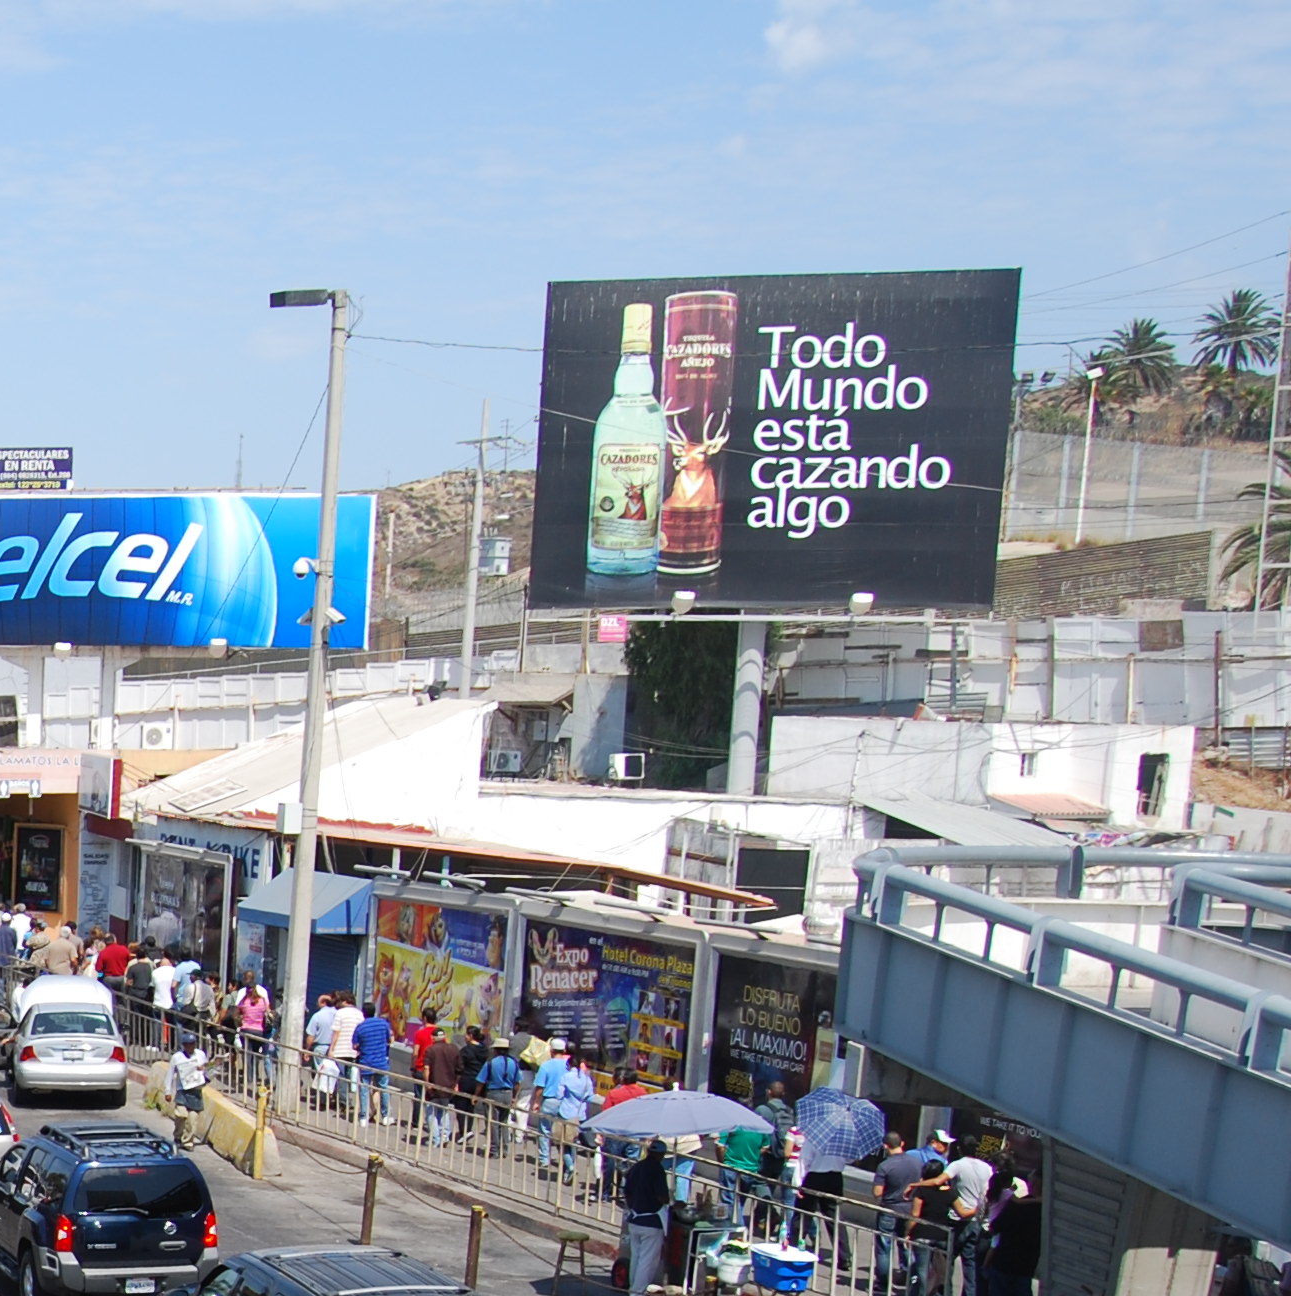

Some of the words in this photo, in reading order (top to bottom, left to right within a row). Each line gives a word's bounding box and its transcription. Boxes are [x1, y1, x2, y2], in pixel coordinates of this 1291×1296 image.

[664, 343, 732, 359] CAZADORES
[758, 321, 887, 369] Todo
[680, 357, 715, 367] AÑEJO
[757, 364, 929, 411] Mundo
[753, 406, 851, 452] está
[4, 460, 19, 471] EN
[20, 460, 56, 471] RENTA
[600, 453, 658, 465] CAZADORES
[751, 444, 951, 490] cazando
[747, 485, 851, 539] algo
[165, 589, 194, 606] M.R.
[555, 943, 589, 967] Expo
[602, 944, 628, 961] Hotel
[629, 949, 665, 970] Corona
[667, 956, 693, 975] Plaza
[530, 964, 598, 997] Renacer
[743, 984, 801, 1013] DISFRUTA
[739, 1007, 756, 1025] LO
[758, 1011, 801, 1036] BUENO
[740, 1051, 755, 1063] TAKE
[756, 1055, 763, 1063] IT
[771, 1057, 790, 1070] YOUR
[752, 1031, 808, 1062] MÁXIMO!
[992, 1119, 1007, 1131] TAKE
[1008, 1123, 1014, 1131] IT
[1016, 1124, 1025, 1135] TO
